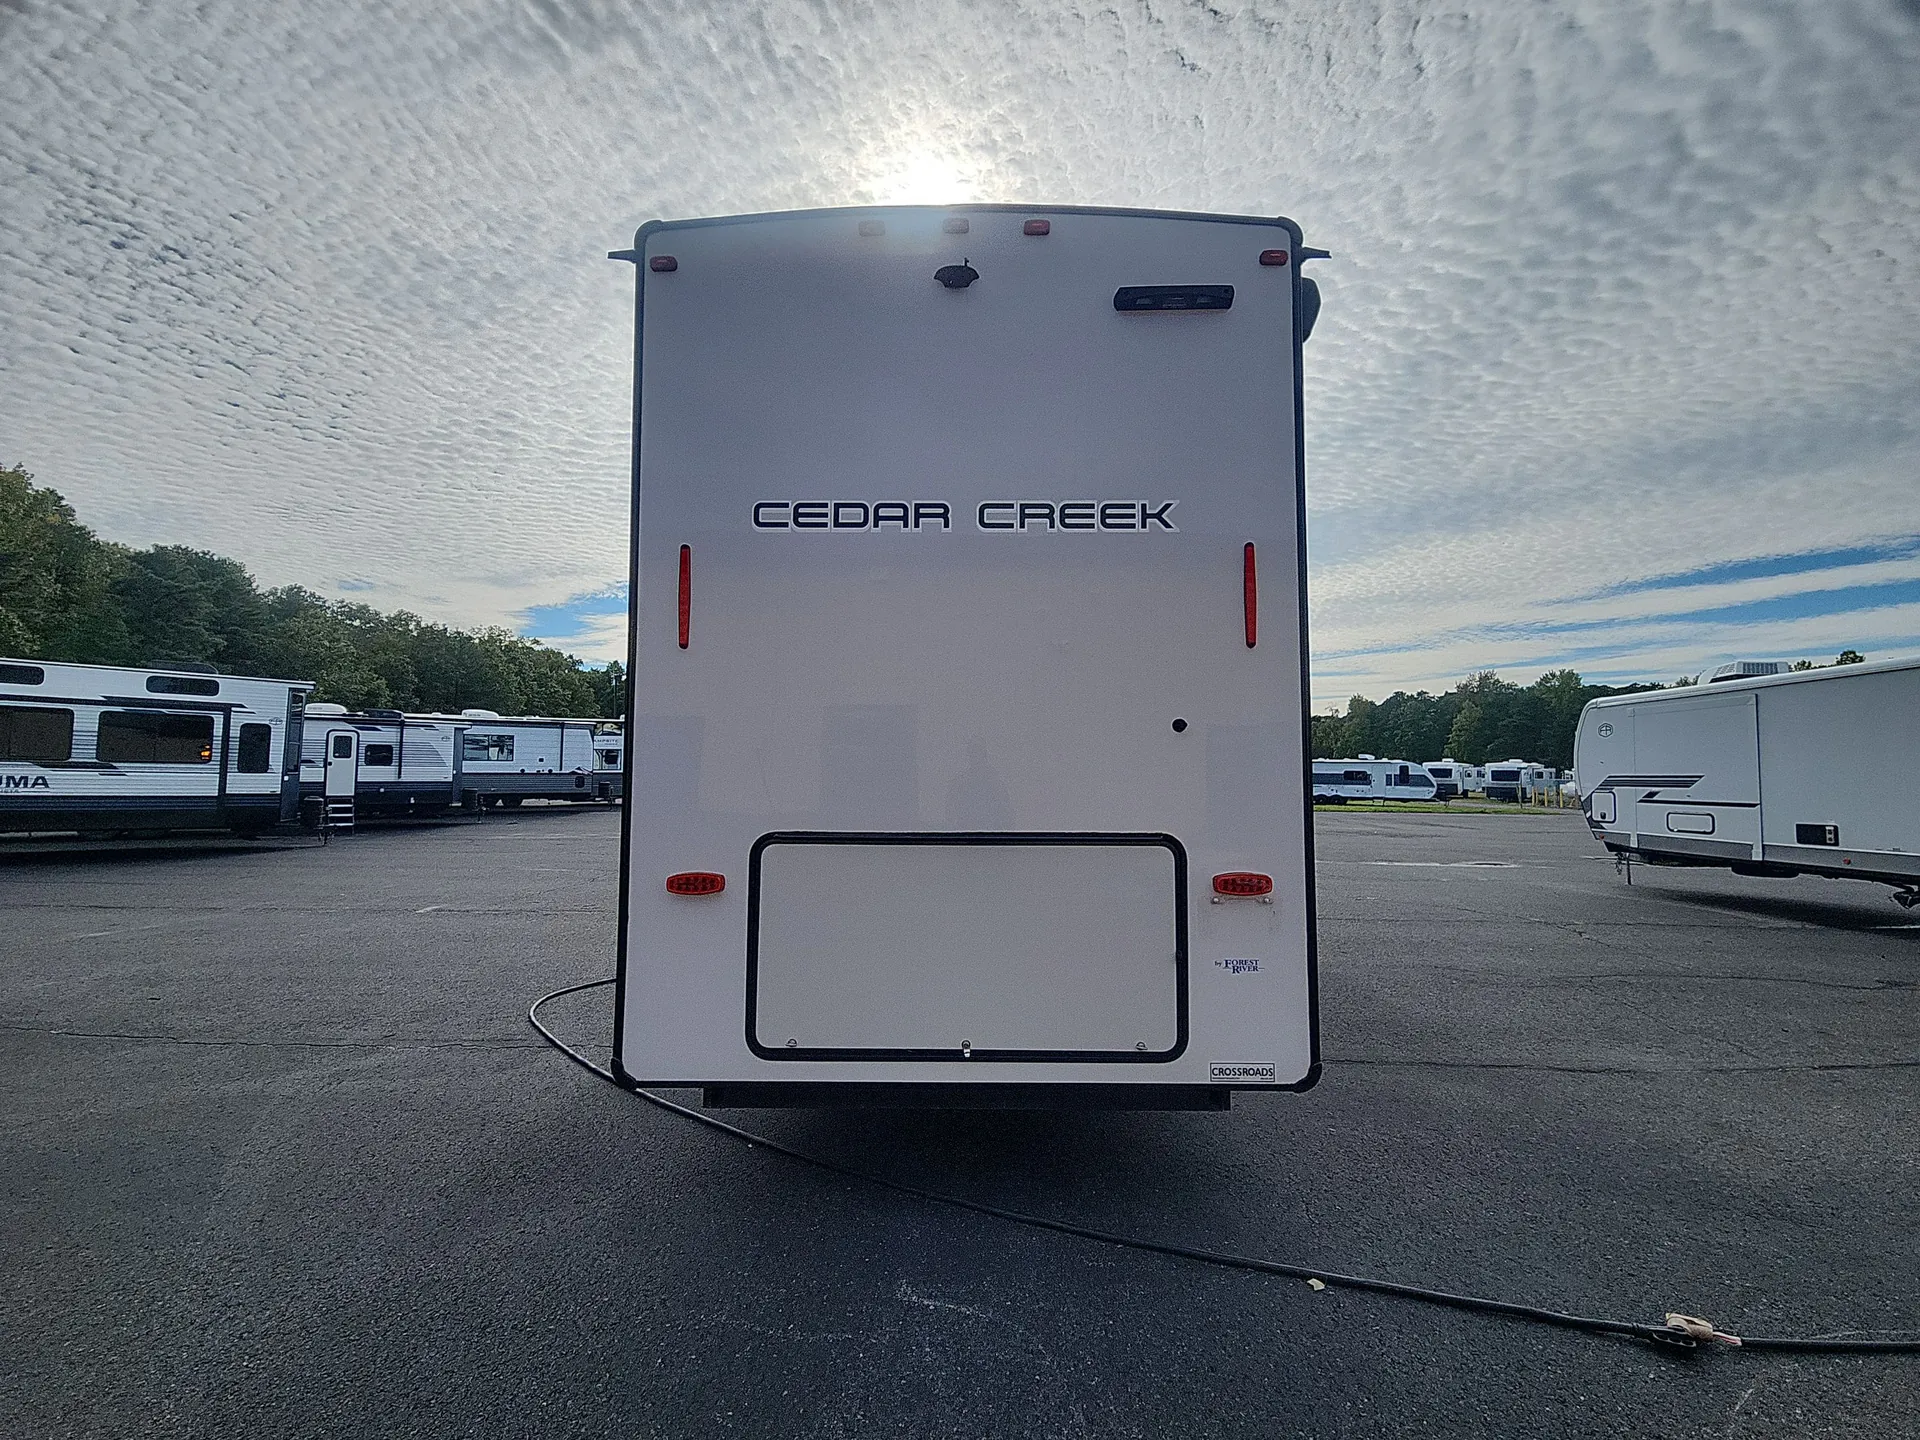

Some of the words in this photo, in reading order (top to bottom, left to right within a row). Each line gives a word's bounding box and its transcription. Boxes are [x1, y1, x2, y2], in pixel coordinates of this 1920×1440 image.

[752, 501, 952, 532] CEDAR
[977, 501, 1180, 532] CREEK
[1223, 959, 1259, 969] FOREST
[1232, 965, 1259, 974] RIVER
[1211, 1067, 1274, 1077] CROSSROADS
